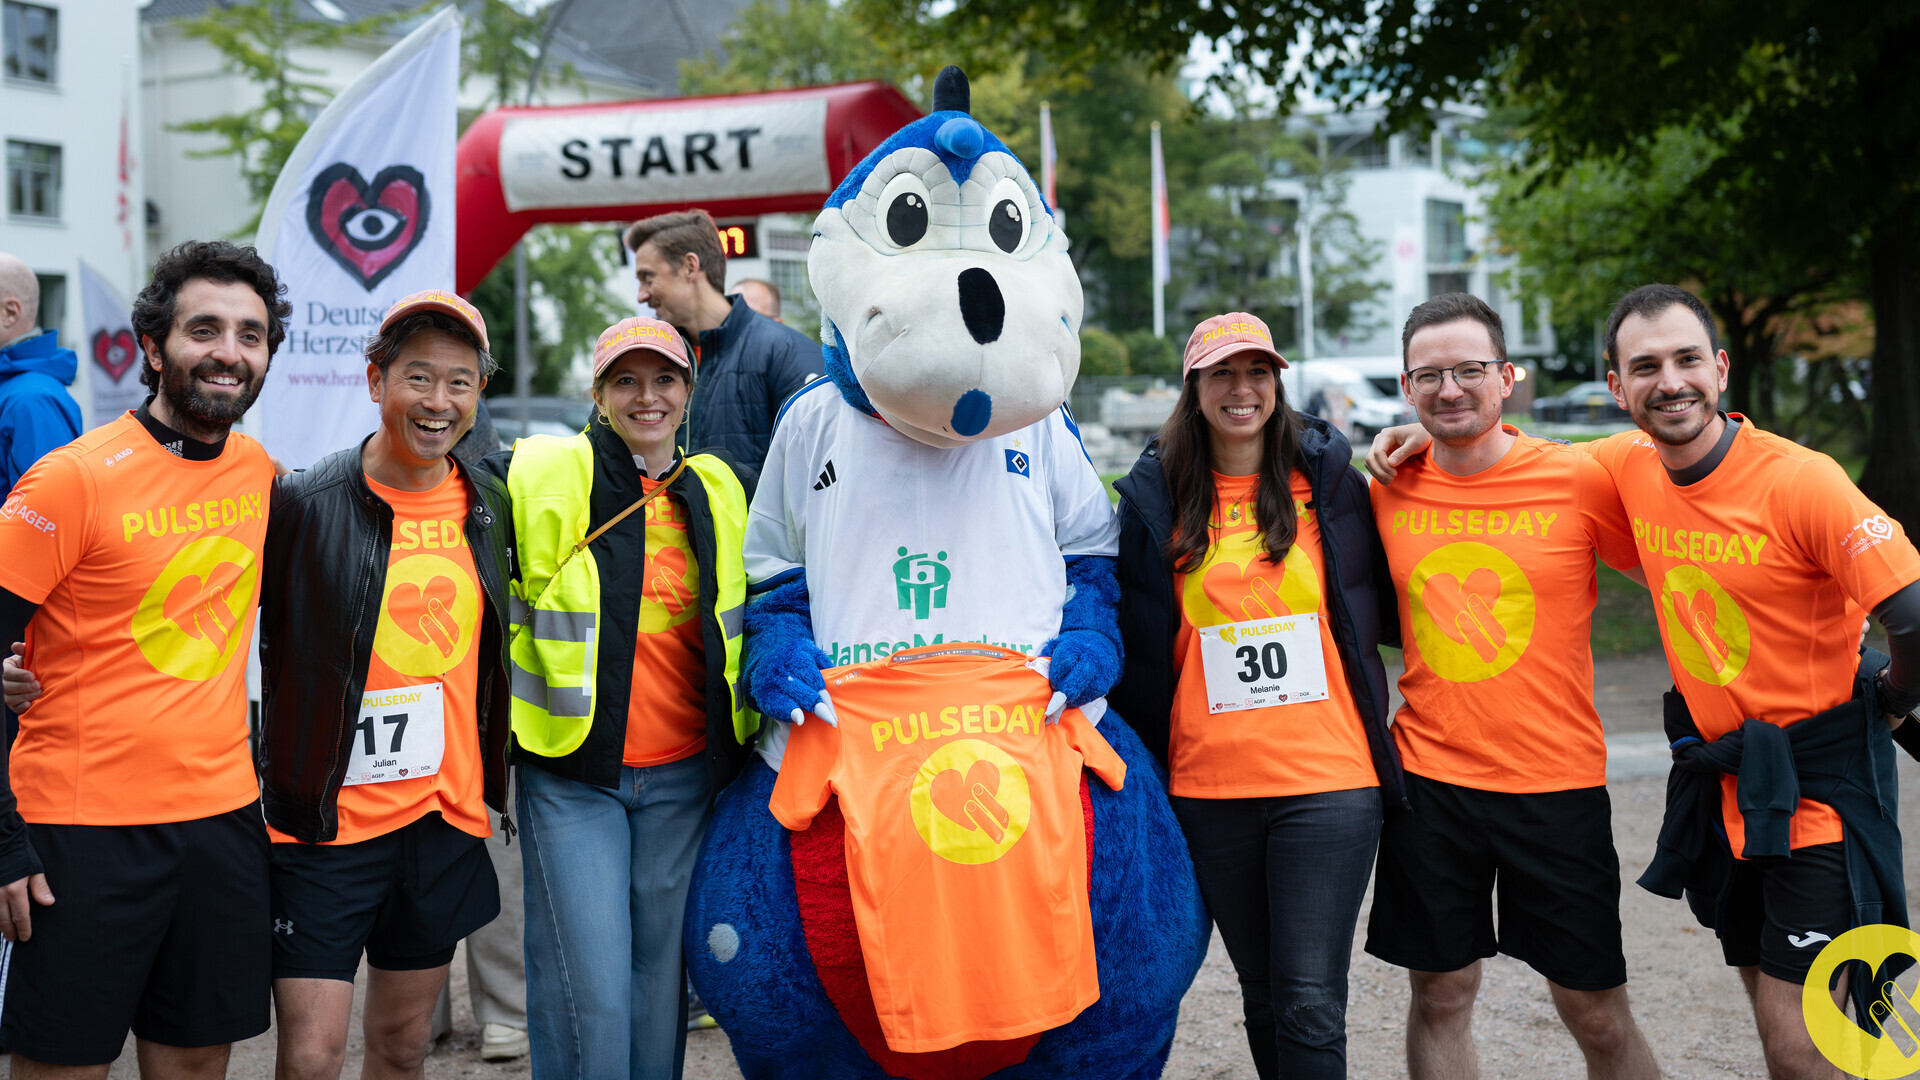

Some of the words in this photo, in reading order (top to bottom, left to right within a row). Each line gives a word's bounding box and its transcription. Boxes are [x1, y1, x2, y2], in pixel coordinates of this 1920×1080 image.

[559, 127, 762, 180] START
[603, 326, 673, 353] PULSEDAY
[113, 447, 134, 462] JAKO
[122, 492, 262, 543] PULSEDAY
[1392, 509, 1558, 537] PULSEDAY
[1633, 517, 1768, 566] PULSEDAY
[1240, 621, 1296, 638] PULSEDAY
[1235, 641, 1288, 683] 30
[362, 691, 422, 709] PULSEDAY
[1250, 683, 1281, 695] Melanie
[357, 712, 409, 756] 17
[871, 704, 1045, 752] PULSEDAY
[372, 758, 397, 769] Julian
